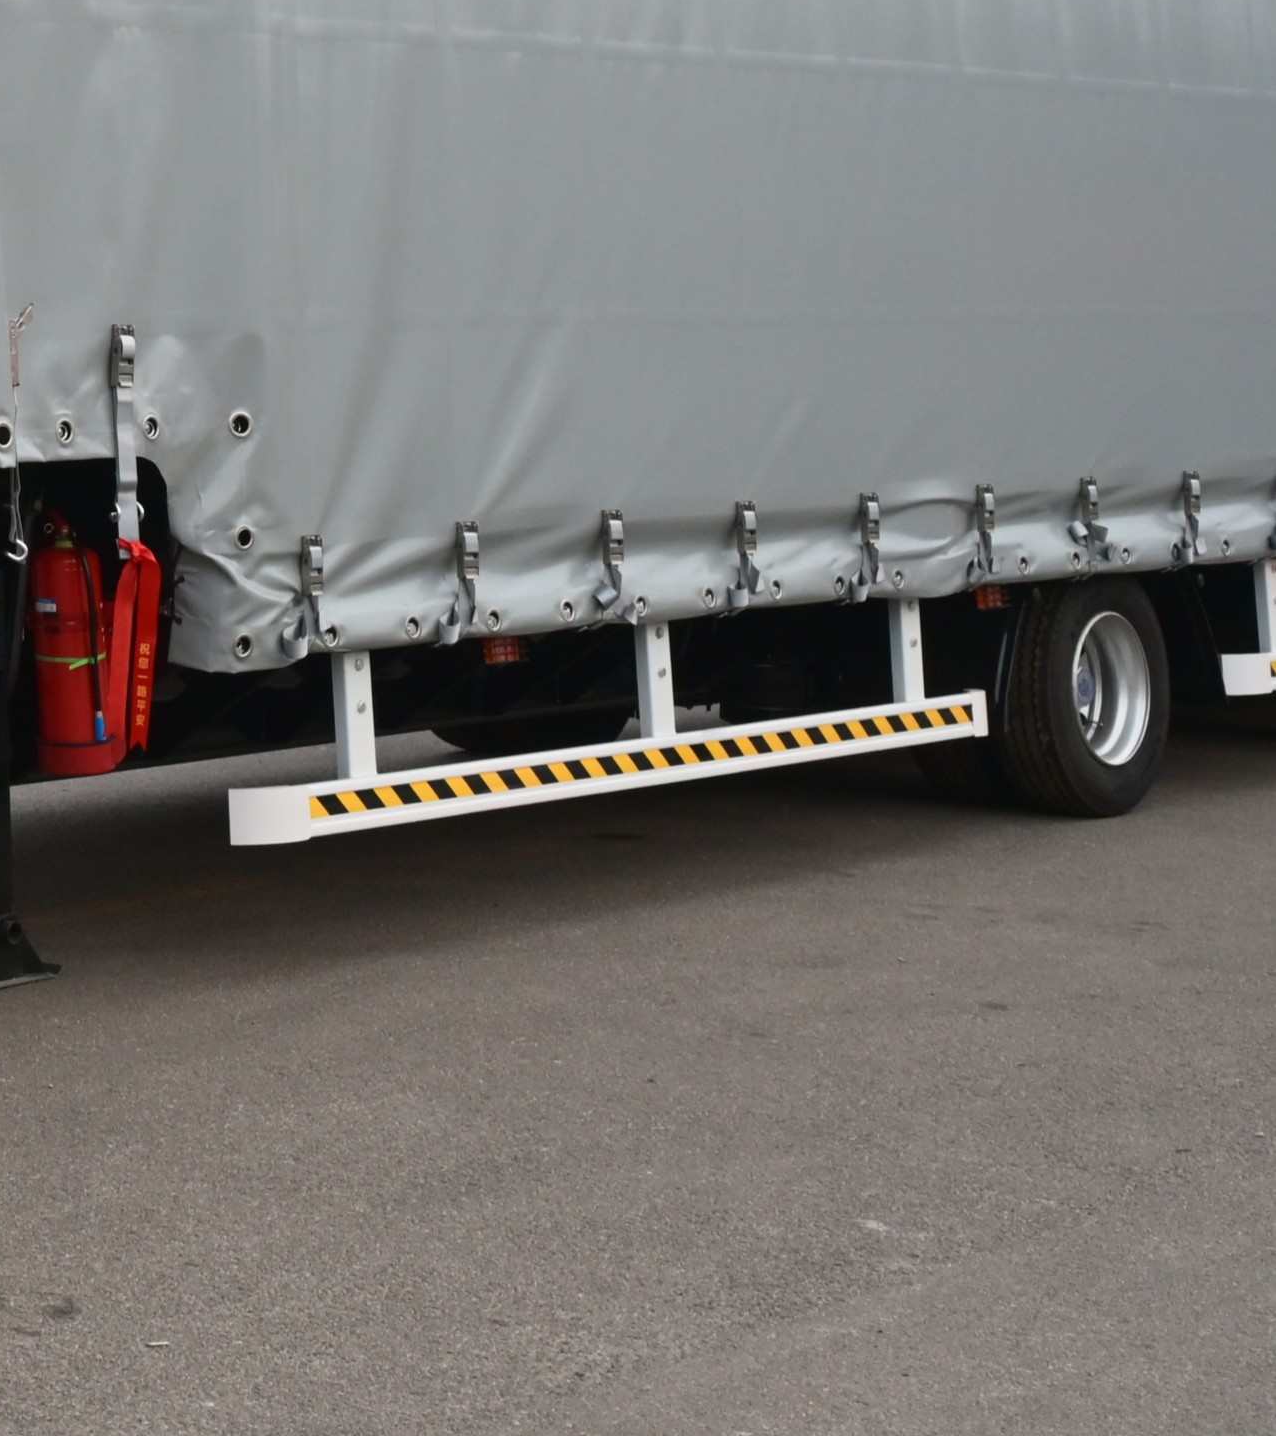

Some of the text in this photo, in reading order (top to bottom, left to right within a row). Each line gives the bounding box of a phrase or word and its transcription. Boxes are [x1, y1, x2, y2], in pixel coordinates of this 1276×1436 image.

[135, 643, 151, 726] 祝您一路平安
